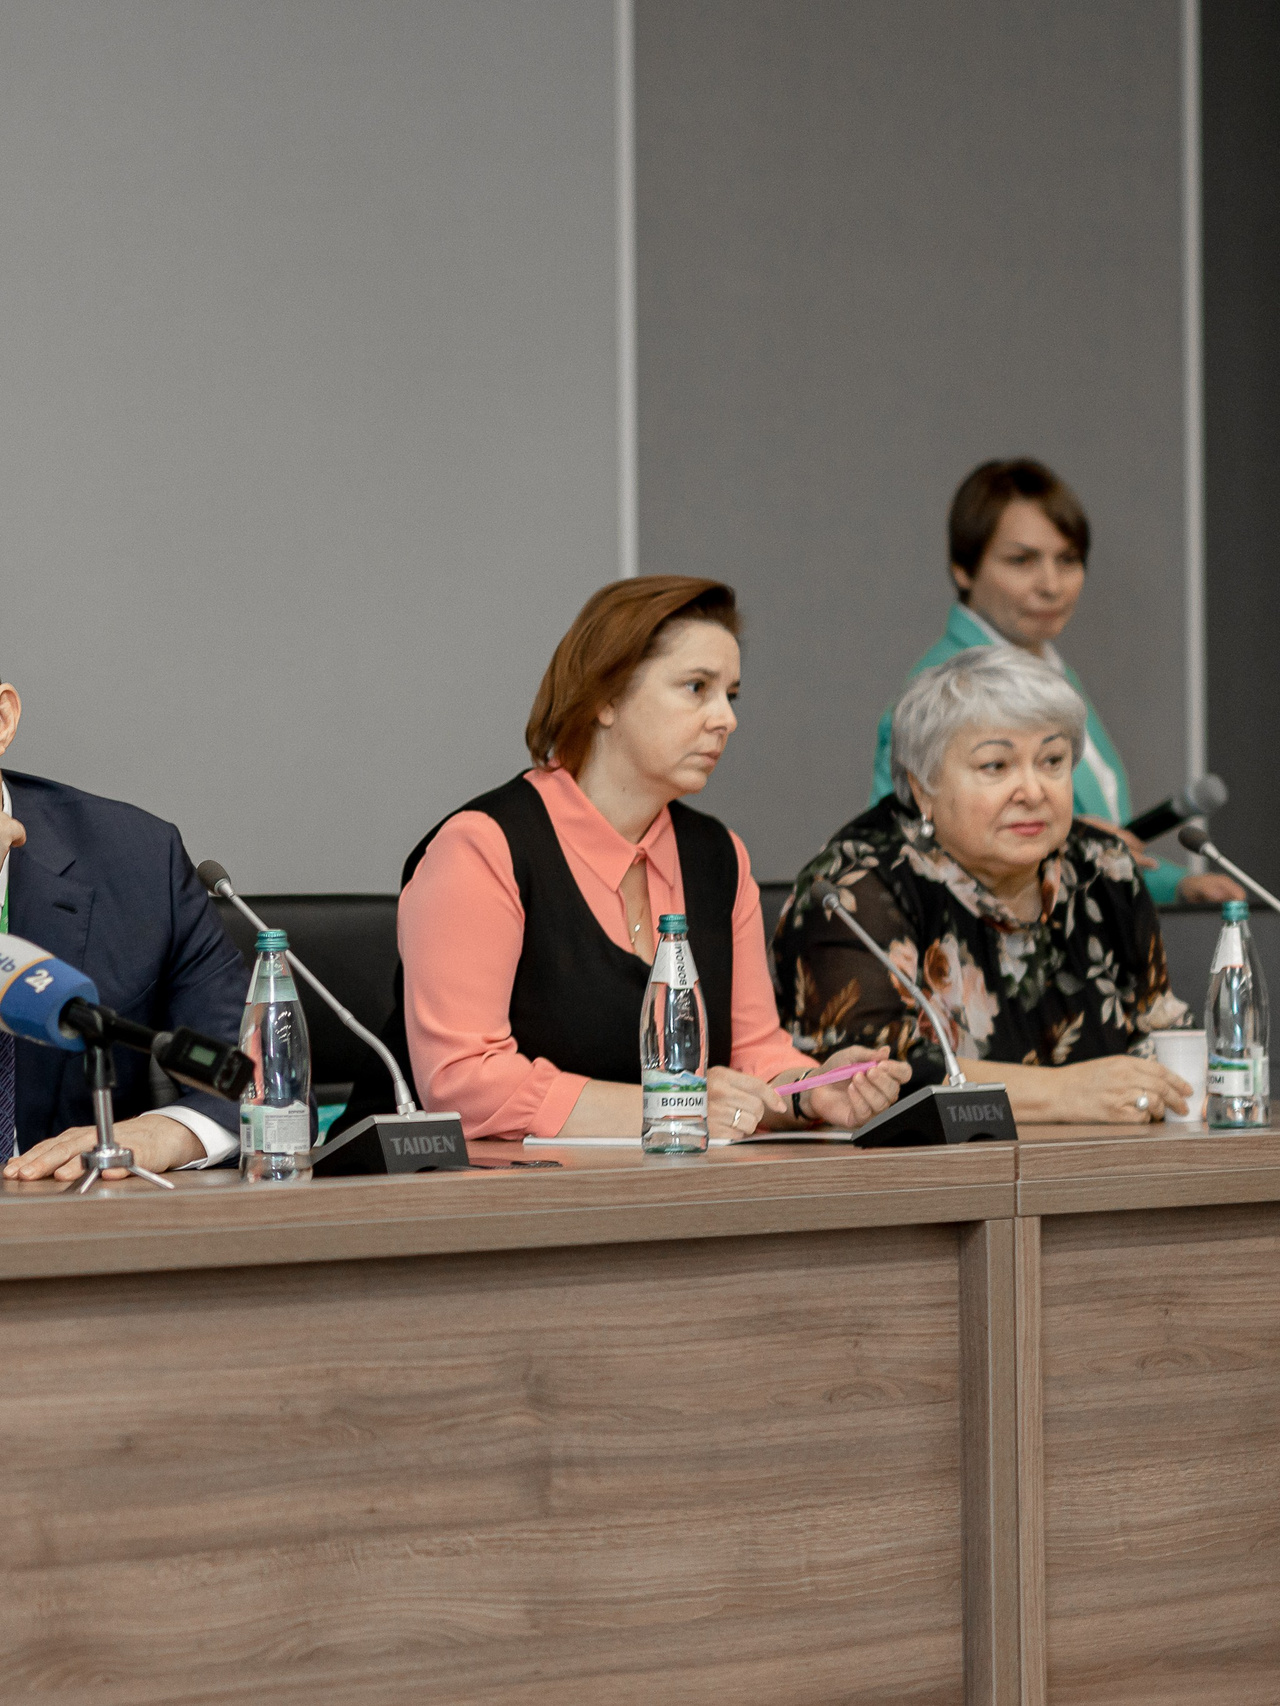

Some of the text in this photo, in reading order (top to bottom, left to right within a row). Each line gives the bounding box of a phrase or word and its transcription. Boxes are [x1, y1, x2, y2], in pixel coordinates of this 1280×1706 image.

[25, 968, 54, 994] 24
[946, 1103, 1005, 1122] TAIDEN
[390, 1135, 456, 1155] TAIDEN
